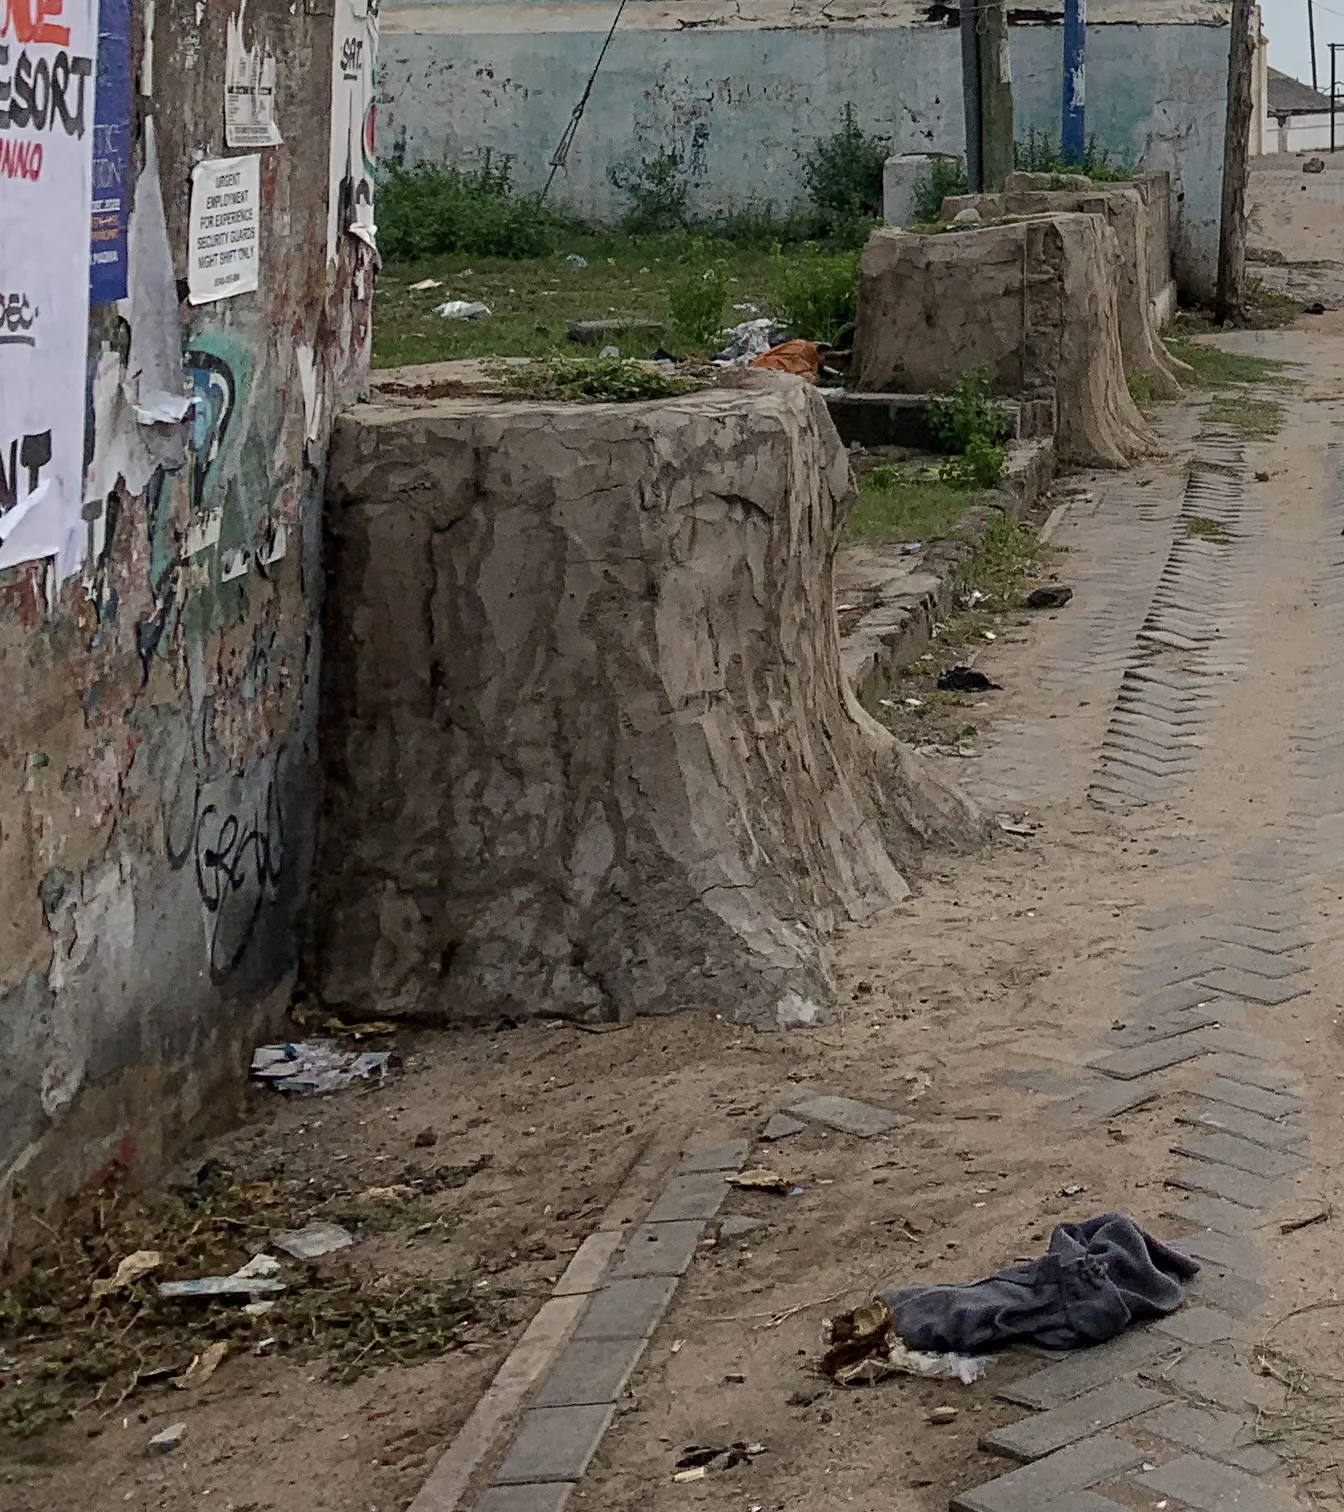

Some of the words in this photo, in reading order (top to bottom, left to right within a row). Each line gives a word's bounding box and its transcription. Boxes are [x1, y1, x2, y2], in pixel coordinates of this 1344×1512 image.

[0, 138, 43, 181] NNO
[215, 172, 241, 188] URGENT
[206, 190, 249, 209] EMPLOYMENT
[200, 215, 214, 229] FOR
[215, 208, 253, 227] EXPERIENCE
[197, 231, 229, 249] SECURITY
[230, 227, 255, 243] GUARDS
